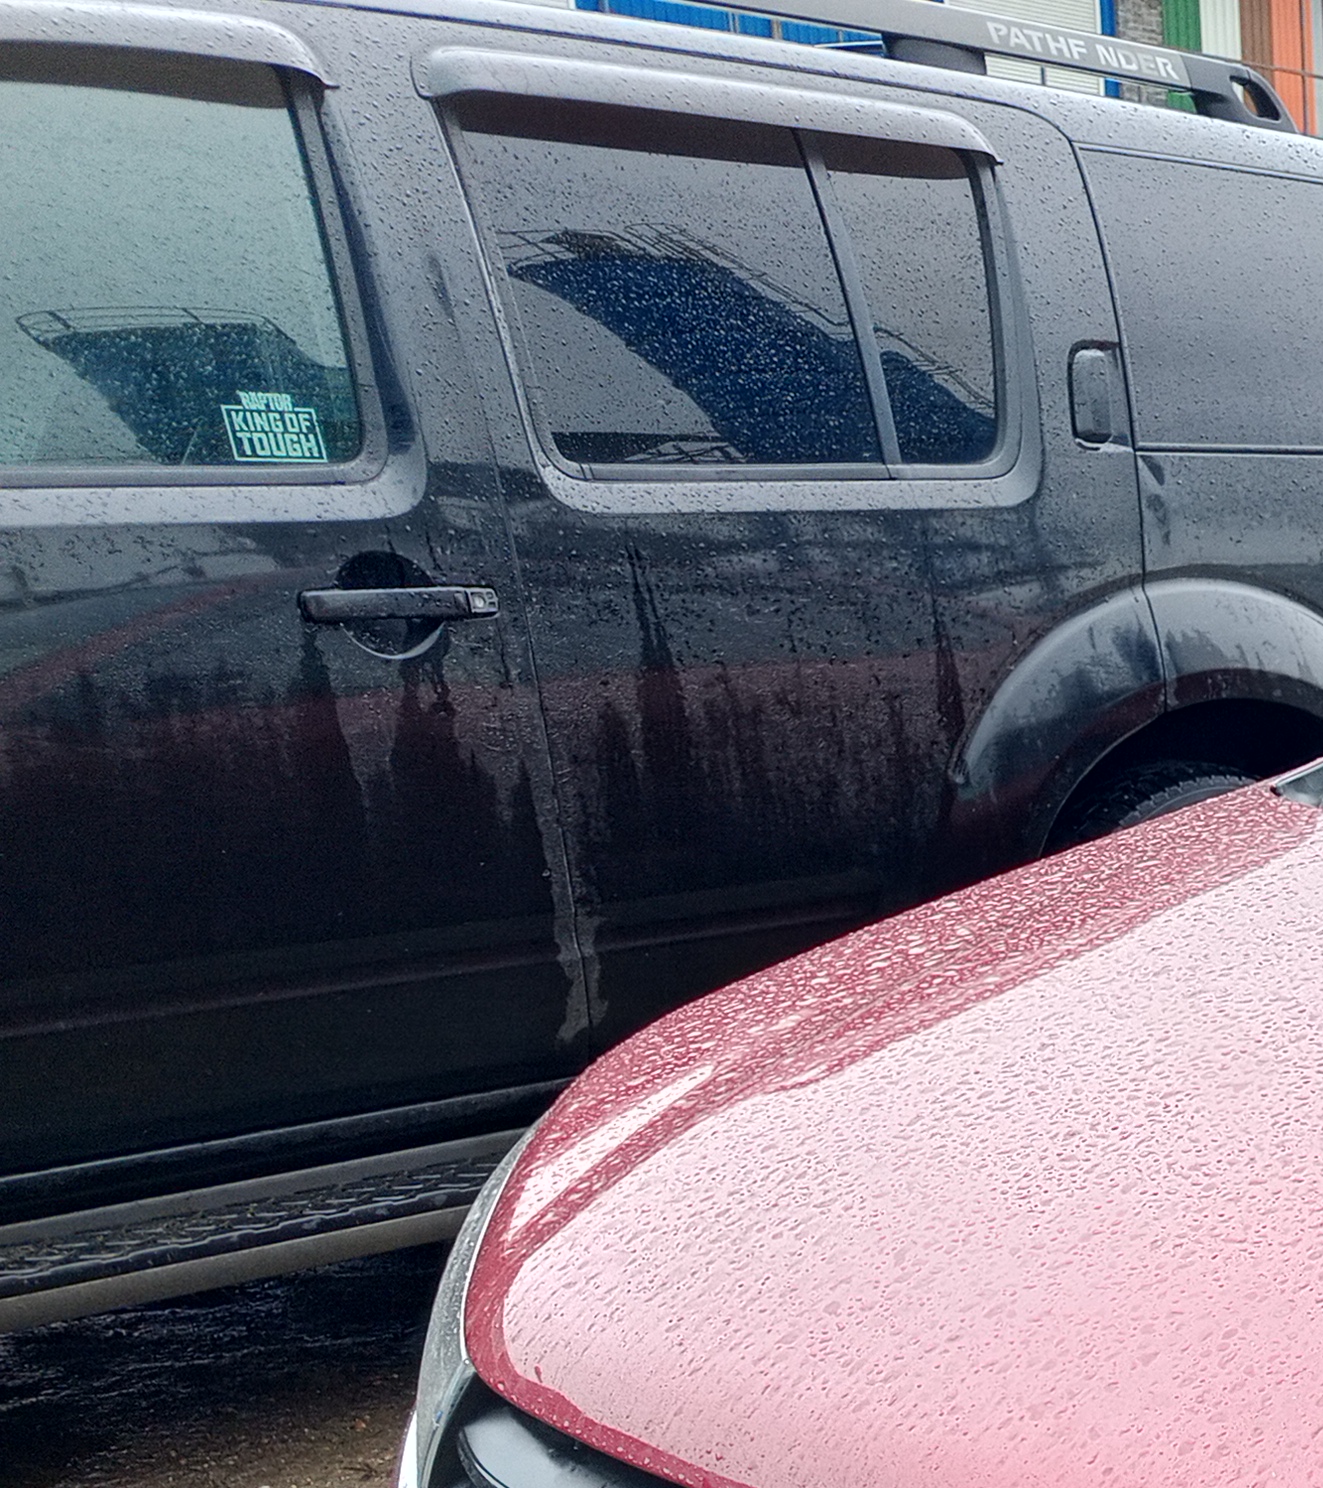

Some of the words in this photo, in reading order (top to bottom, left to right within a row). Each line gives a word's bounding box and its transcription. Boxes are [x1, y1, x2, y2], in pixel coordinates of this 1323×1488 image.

[986, 21, 1180, 80] PATHFNDER
[237, 390, 293, 410] RAPTOR
[230, 411, 284, 432] KING
[284, 413, 311, 432] OF
[235, 432, 320, 457] TOUGH
